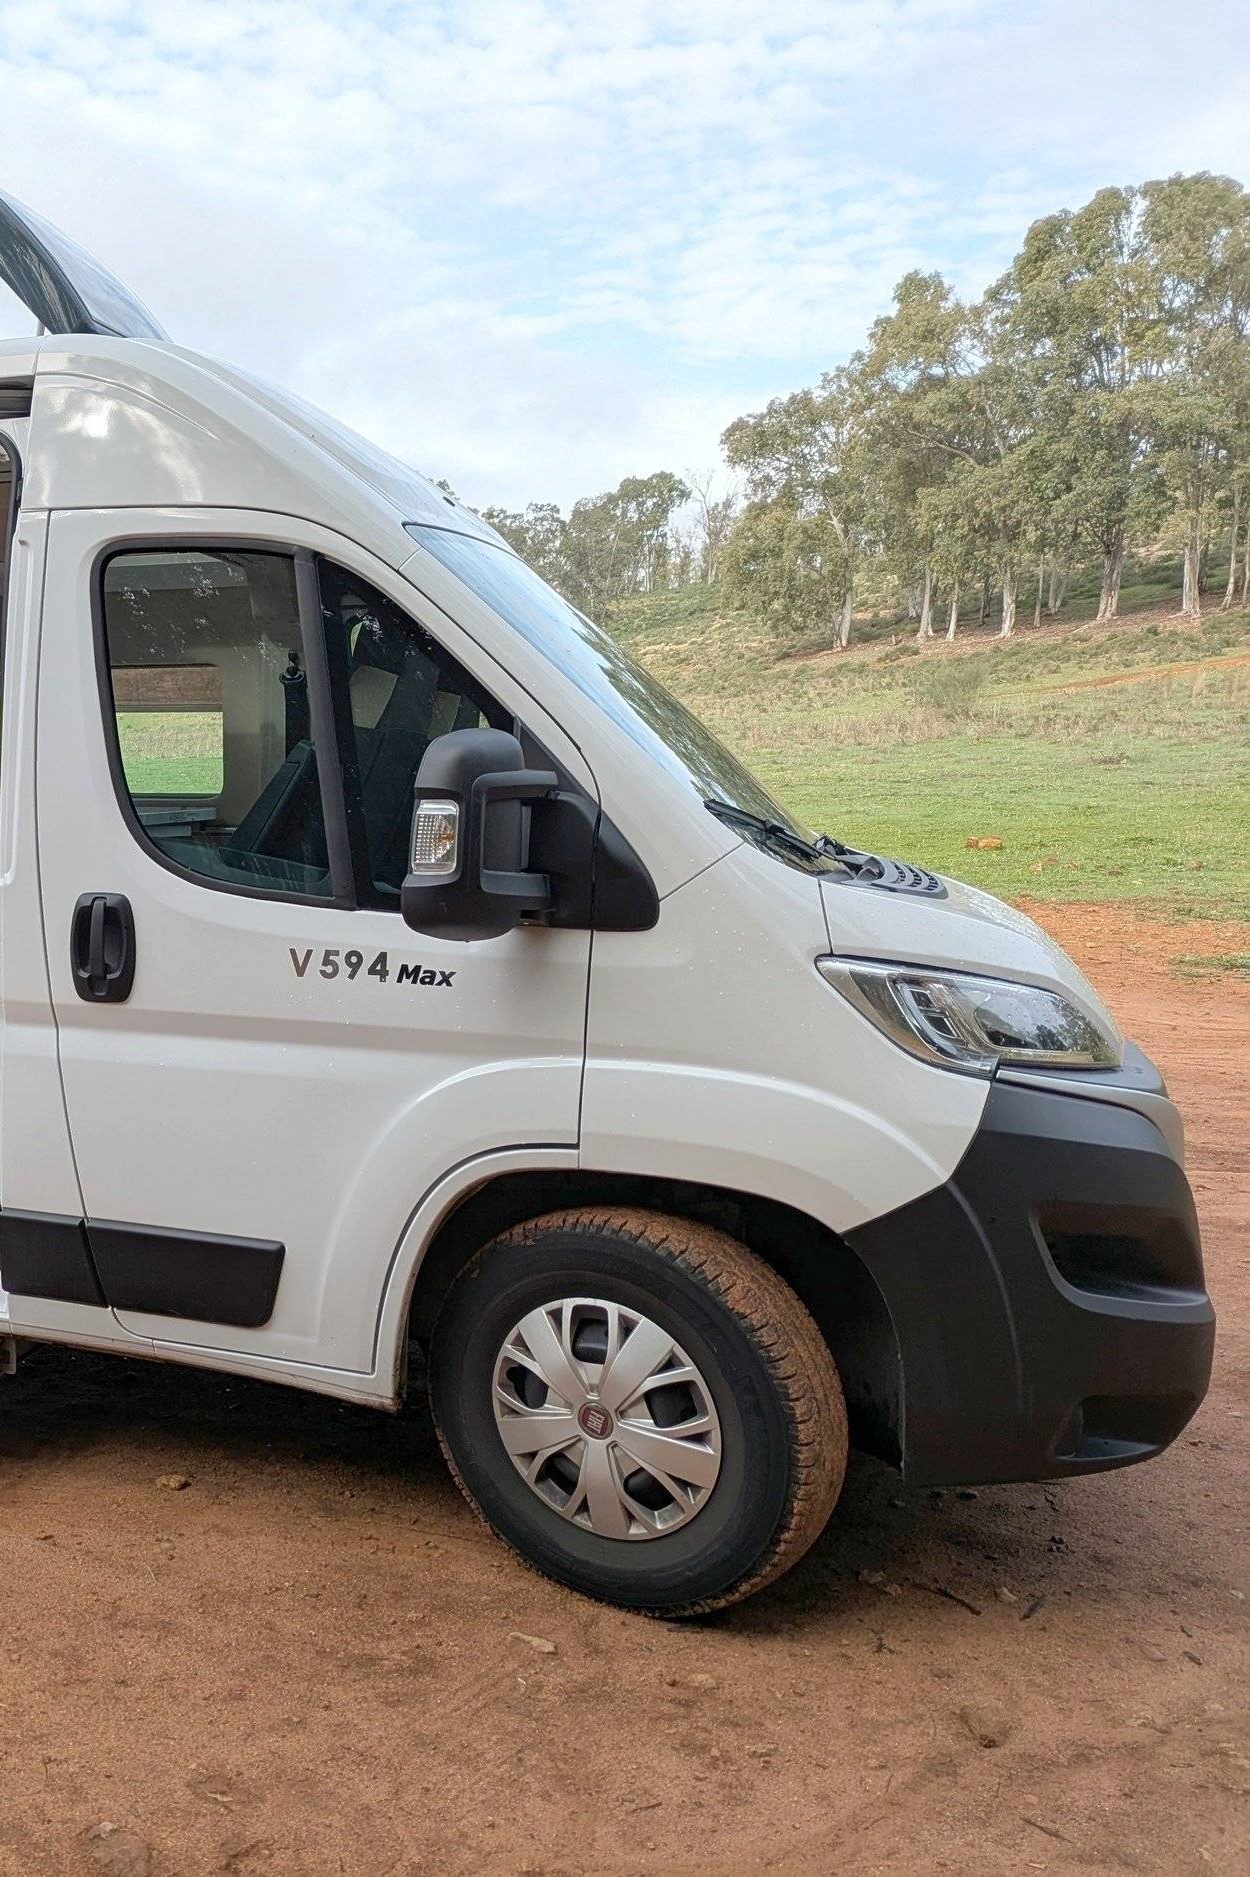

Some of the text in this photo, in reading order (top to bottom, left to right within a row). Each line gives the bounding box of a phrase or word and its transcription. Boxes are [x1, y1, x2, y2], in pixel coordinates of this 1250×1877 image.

[288, 948, 457, 987] V 594 Max
[586, 1410, 605, 1434] FIAT
